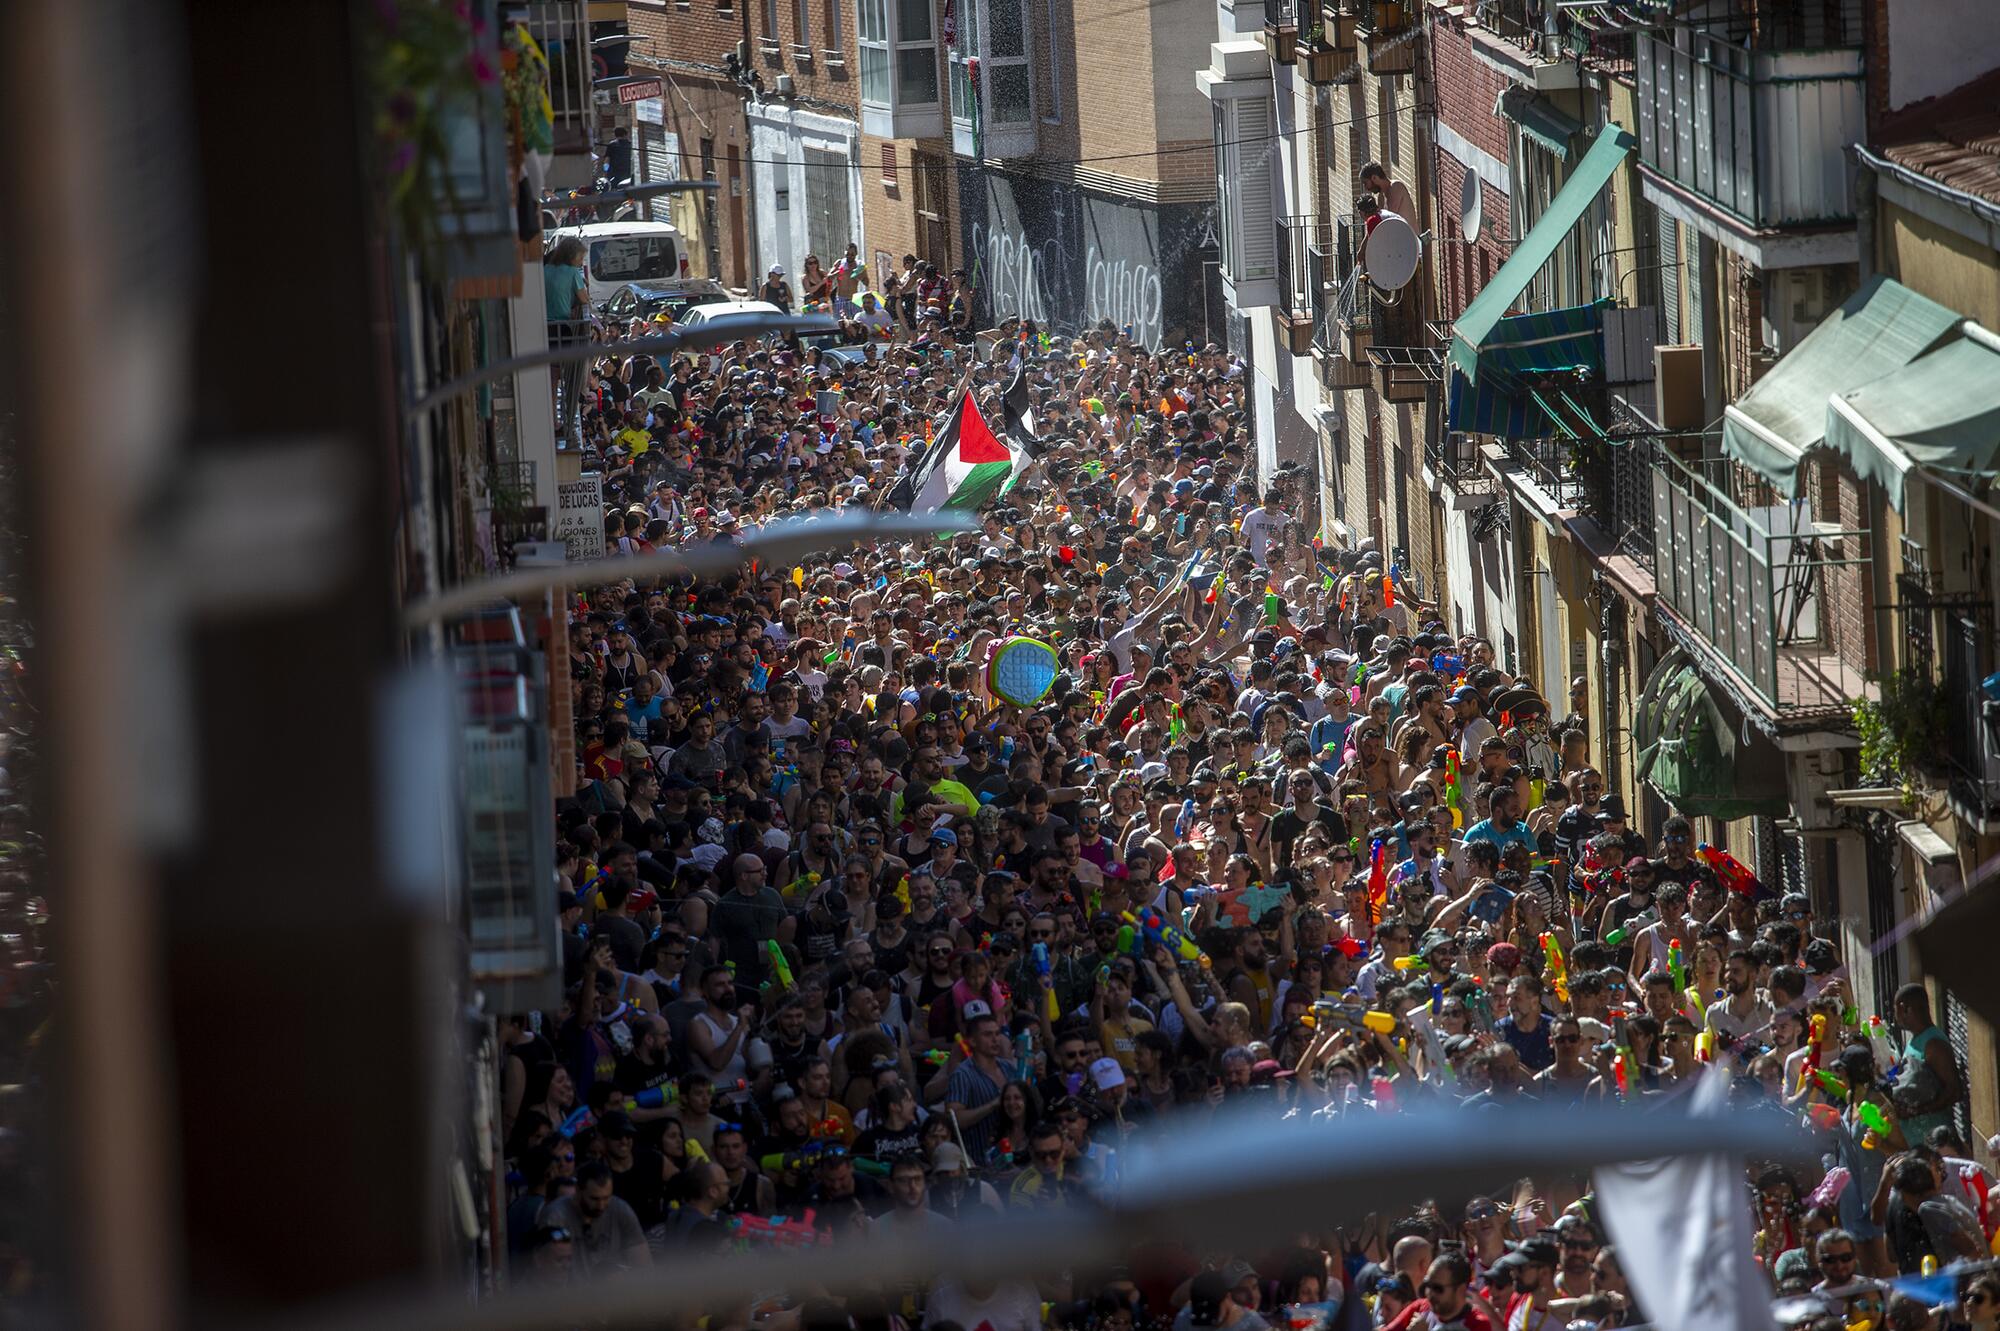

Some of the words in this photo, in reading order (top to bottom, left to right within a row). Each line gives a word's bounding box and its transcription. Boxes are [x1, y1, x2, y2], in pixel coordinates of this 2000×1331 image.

[621, 82, 660, 101] LOCUTORIO
[559, 495, 570, 509] DE
[572, 494, 599, 508] LUCAS
[577, 516, 584, 525] &
[560, 527, 597, 536] CIONES
[583, 537, 599, 546] 731
[583, 548, 601, 557] 646
